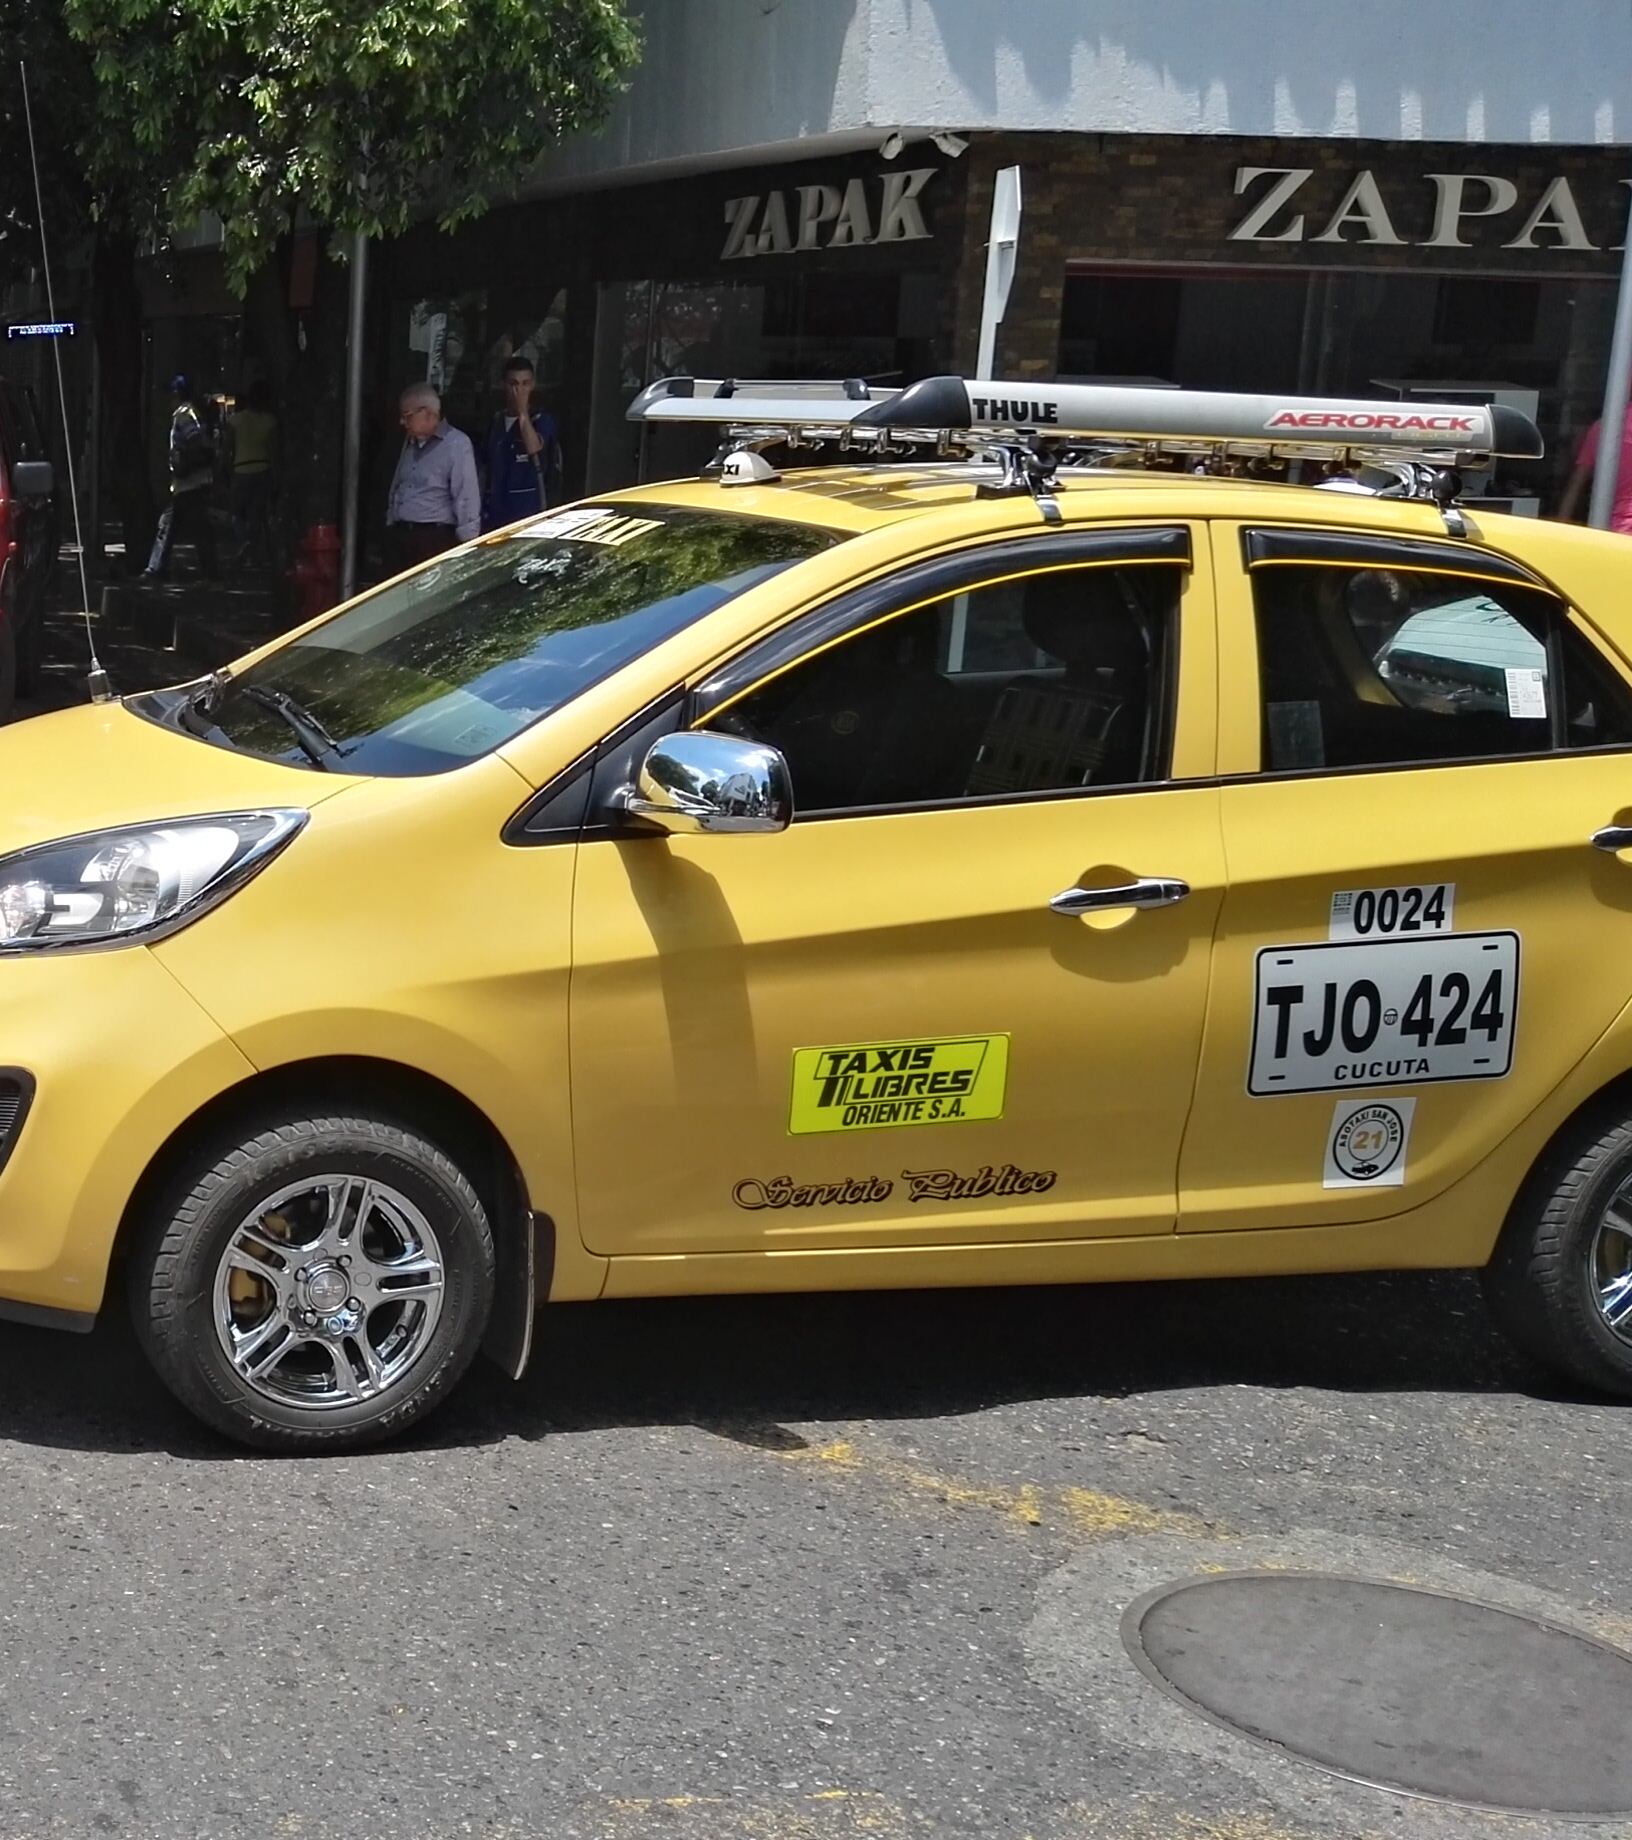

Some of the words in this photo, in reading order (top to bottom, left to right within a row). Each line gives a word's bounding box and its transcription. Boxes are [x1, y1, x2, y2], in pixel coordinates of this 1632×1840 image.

[720, 168, 939, 260] ZAPAK
[1226, 167, 1631, 251] ZAPA
[971, 398, 1059, 424] THULE
[1269, 412, 1476, 432] AERORACK
[1353, 885, 1446, 935] 0024
[1266, 979, 1382, 1059] TJO
[1400, 968, 1505, 1048] 424
[827, 1047, 936, 1076] TAXIS
[1333, 1058, 1430, 1081] CUCUTA
[851, 1069, 974, 1101] LIBRES
[841, 1100, 927, 1127] ORIENTE
[928, 1098, 966, 1120] S.A.
[1371, 1109, 1389, 1121] SAN
[1352, 1130, 1383, 1150] 21
[731, 1175, 894, 1211] Servicio
[900, 1164, 1058, 1204] Publico
